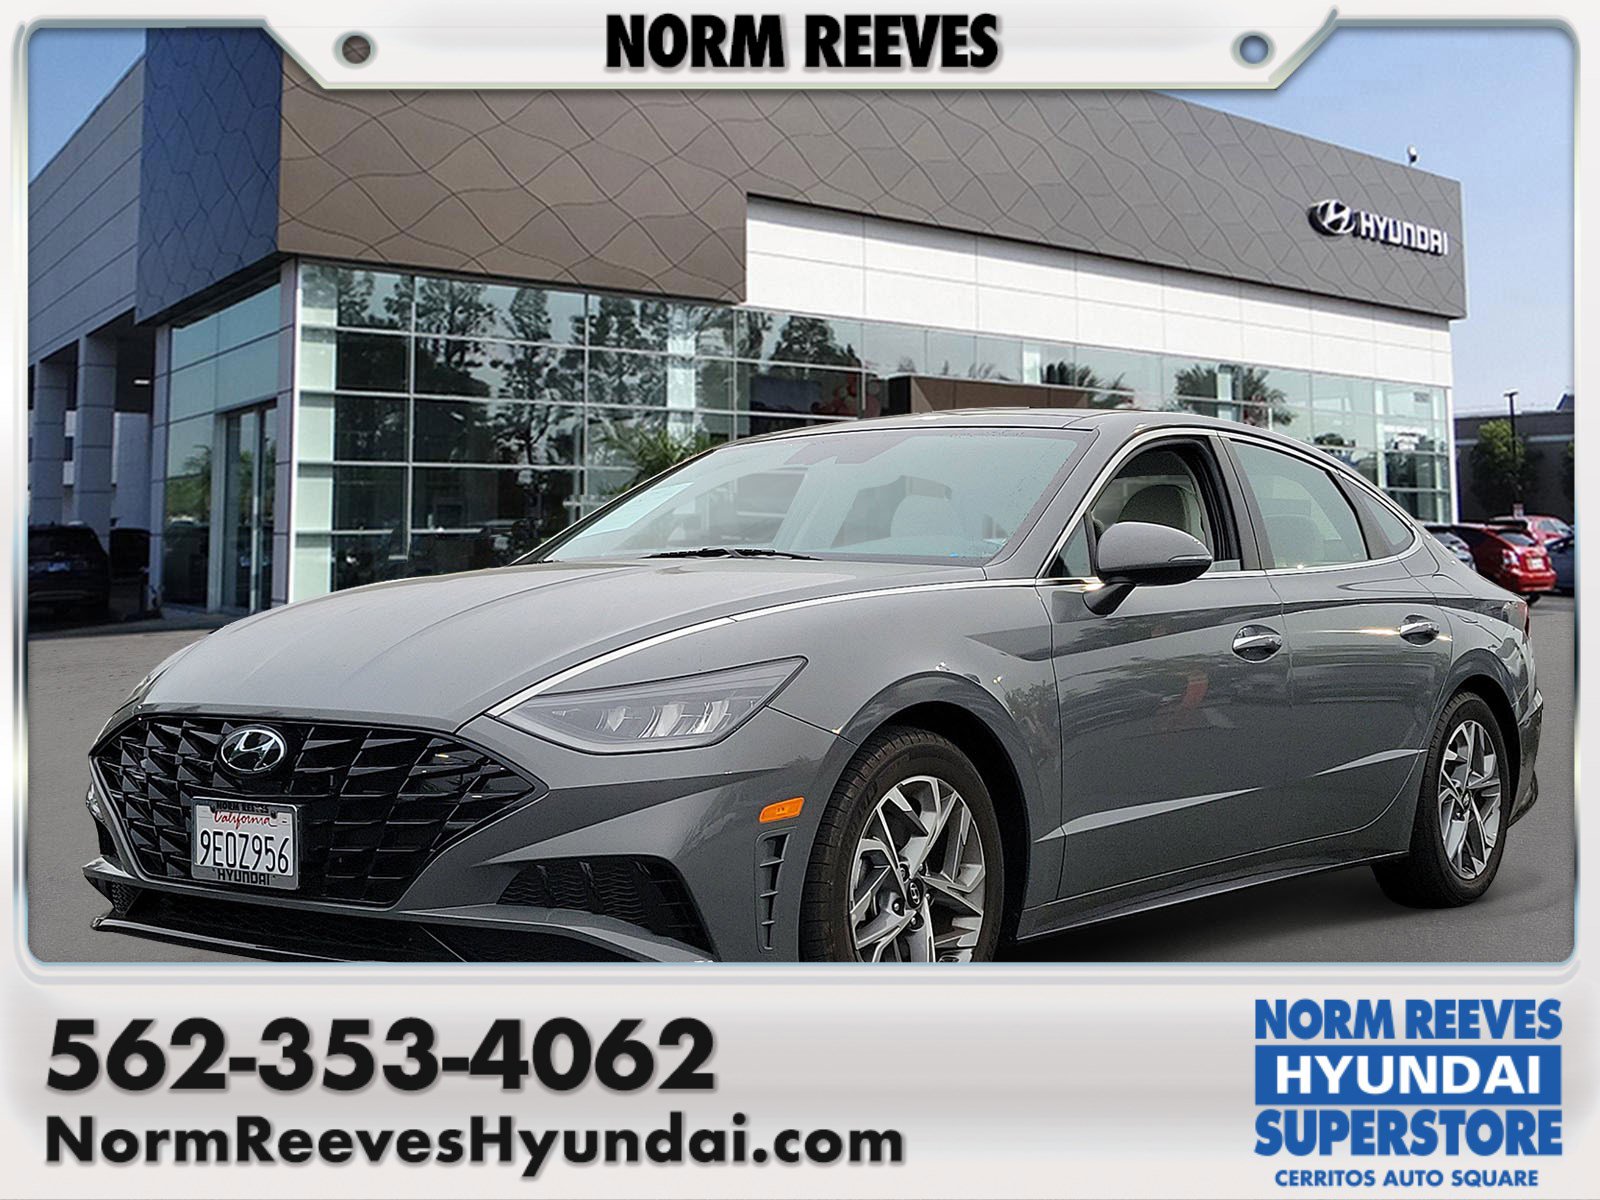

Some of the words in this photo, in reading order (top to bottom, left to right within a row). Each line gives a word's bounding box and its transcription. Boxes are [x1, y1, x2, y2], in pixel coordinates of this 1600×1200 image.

[1360, 211, 1448, 255] HYUNDAI
[214, 811, 270, 830] California
[217, 868, 270, 885] HYUNDAI
